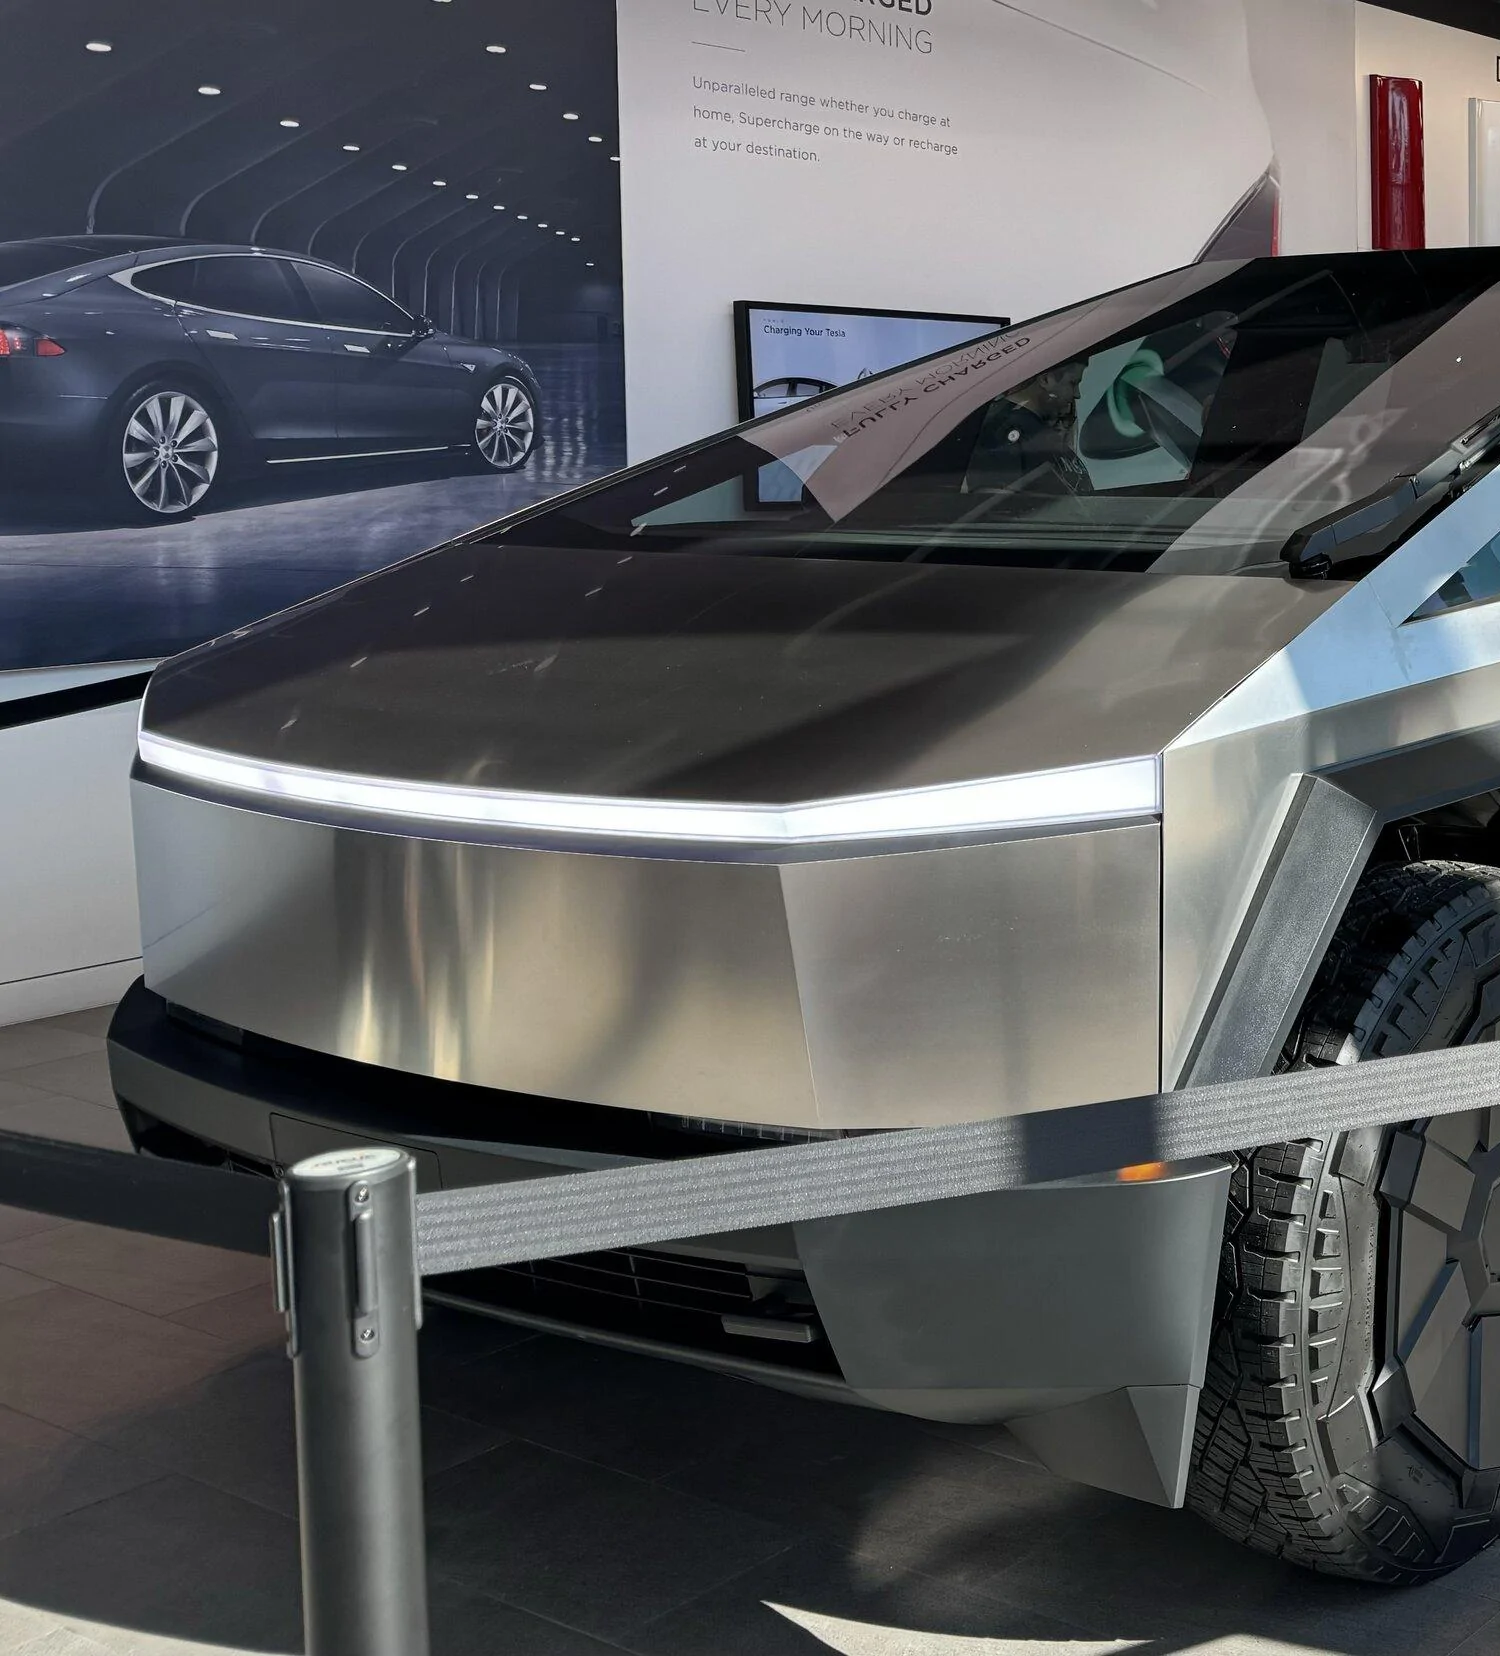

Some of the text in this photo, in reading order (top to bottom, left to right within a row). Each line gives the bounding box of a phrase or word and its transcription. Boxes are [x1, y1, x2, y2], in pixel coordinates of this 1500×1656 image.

[802, 5, 933, 54] MORNING
[692, 76, 951, 129] Unparalleled range whether you charge at
[693, 105, 958, 156] home, Supercharge on the way or recharge
[694, 137, 821, 163] at your destination.
[763, 325, 847, 338] Charging Your Tesla
